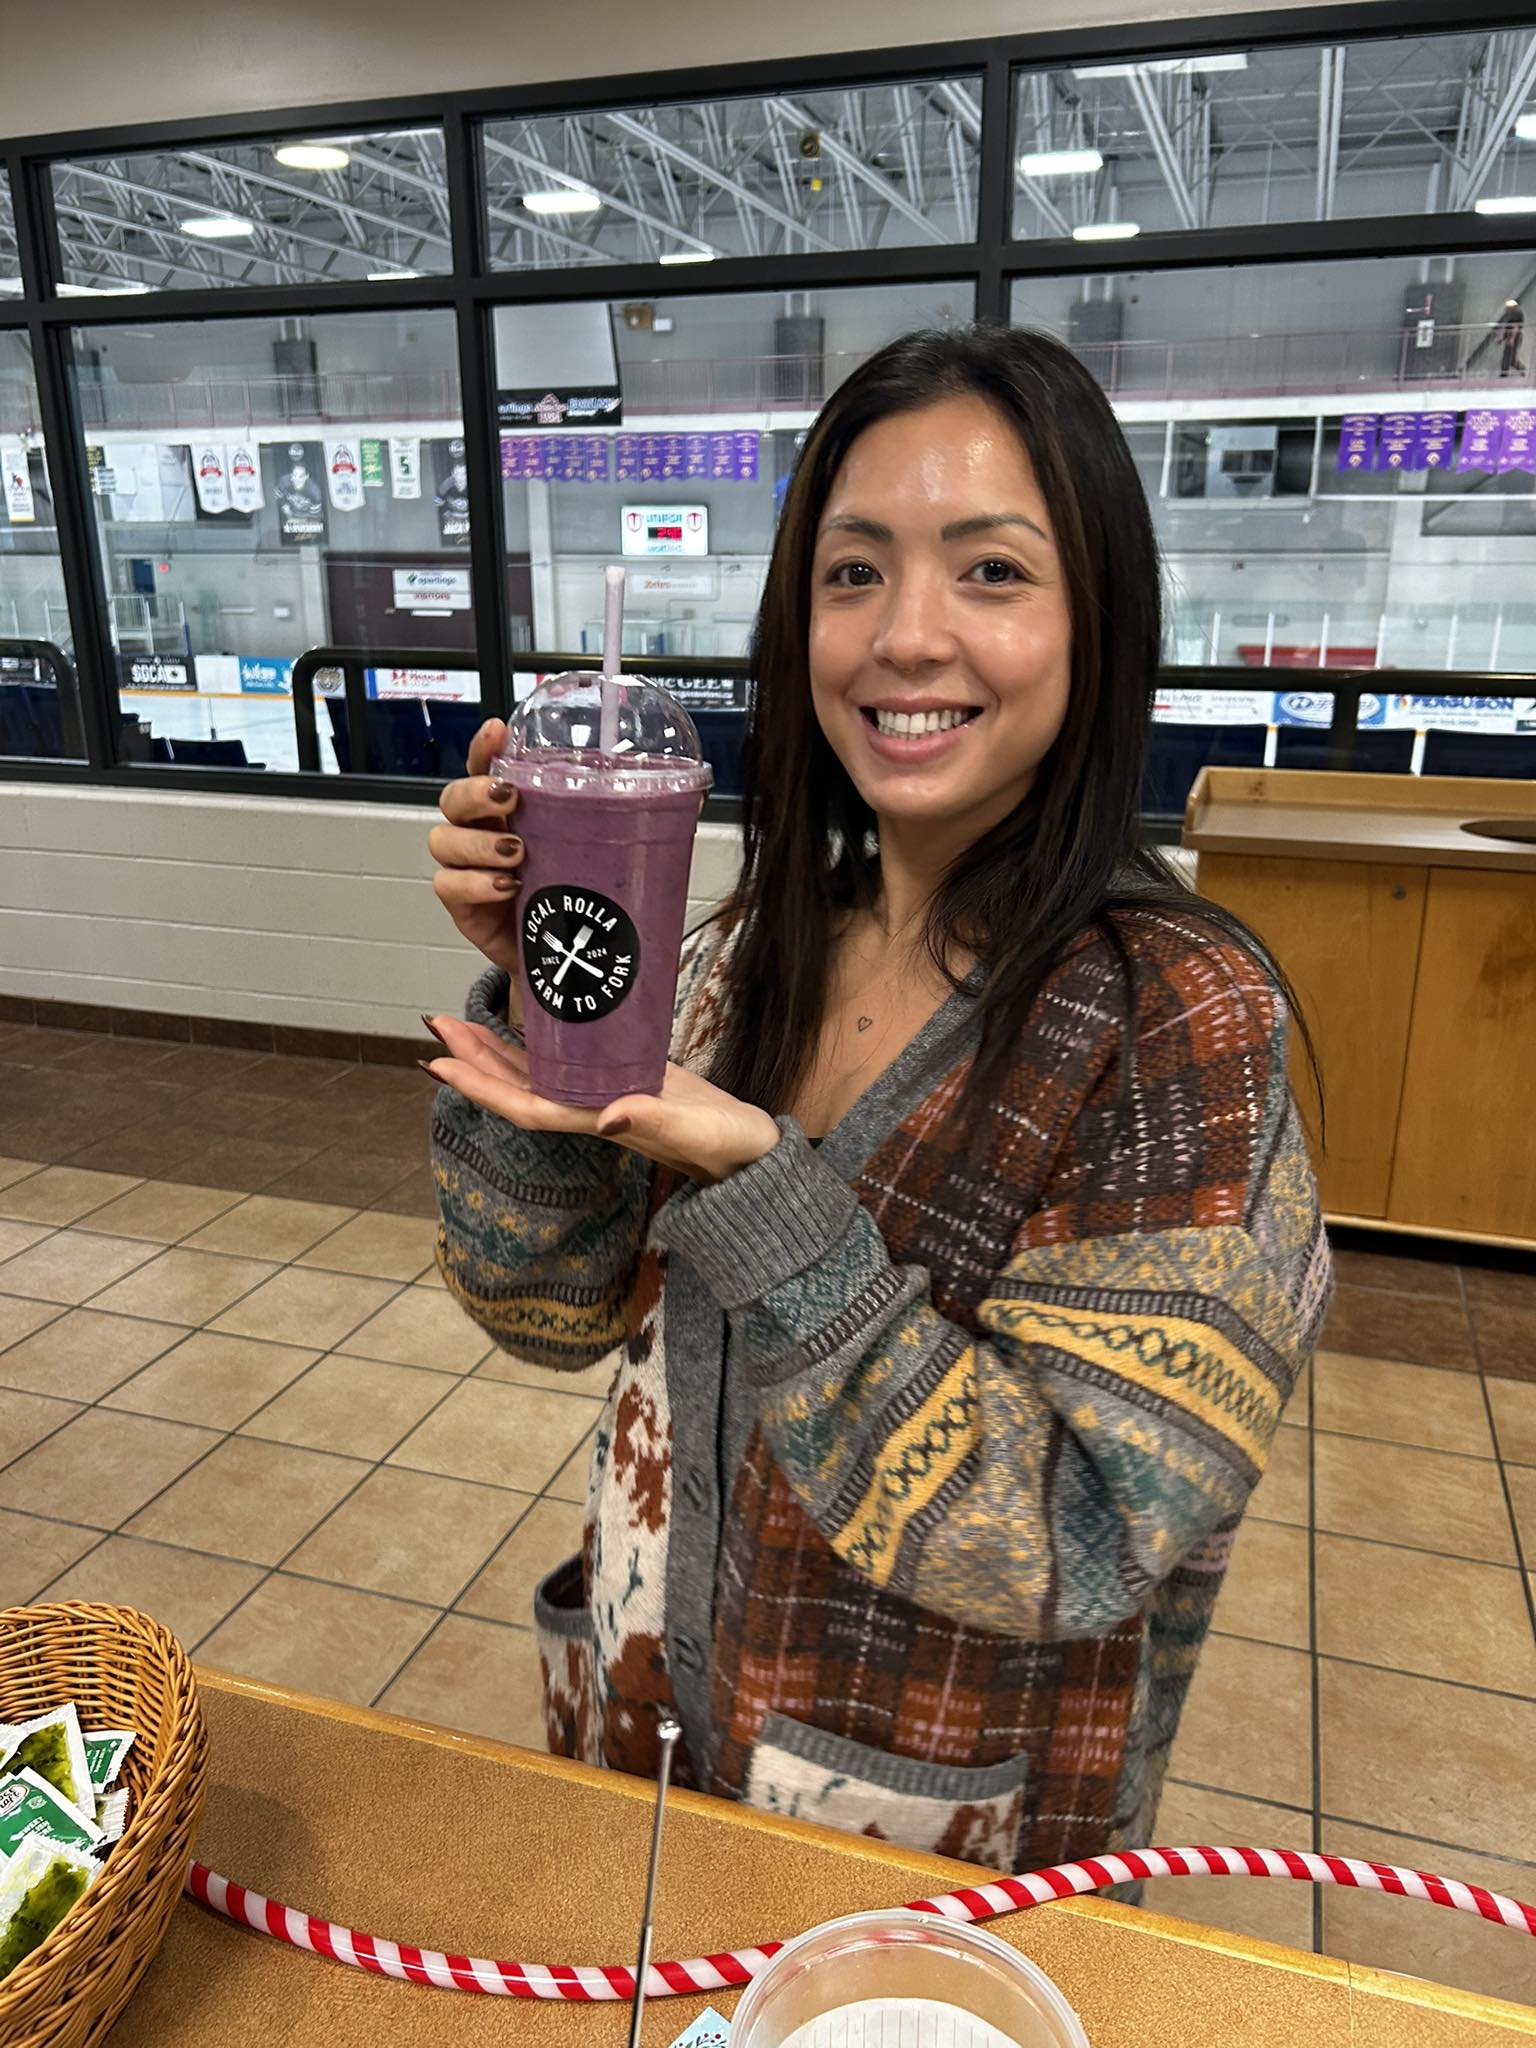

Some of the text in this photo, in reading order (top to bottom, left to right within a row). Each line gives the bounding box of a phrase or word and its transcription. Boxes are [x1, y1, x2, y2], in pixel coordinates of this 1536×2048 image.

[526, 895, 618, 943] LOCAL ROLLA
[541, 948, 608, 965] SINCE 2024
[530, 954, 632, 1013] FARM TO FORK
